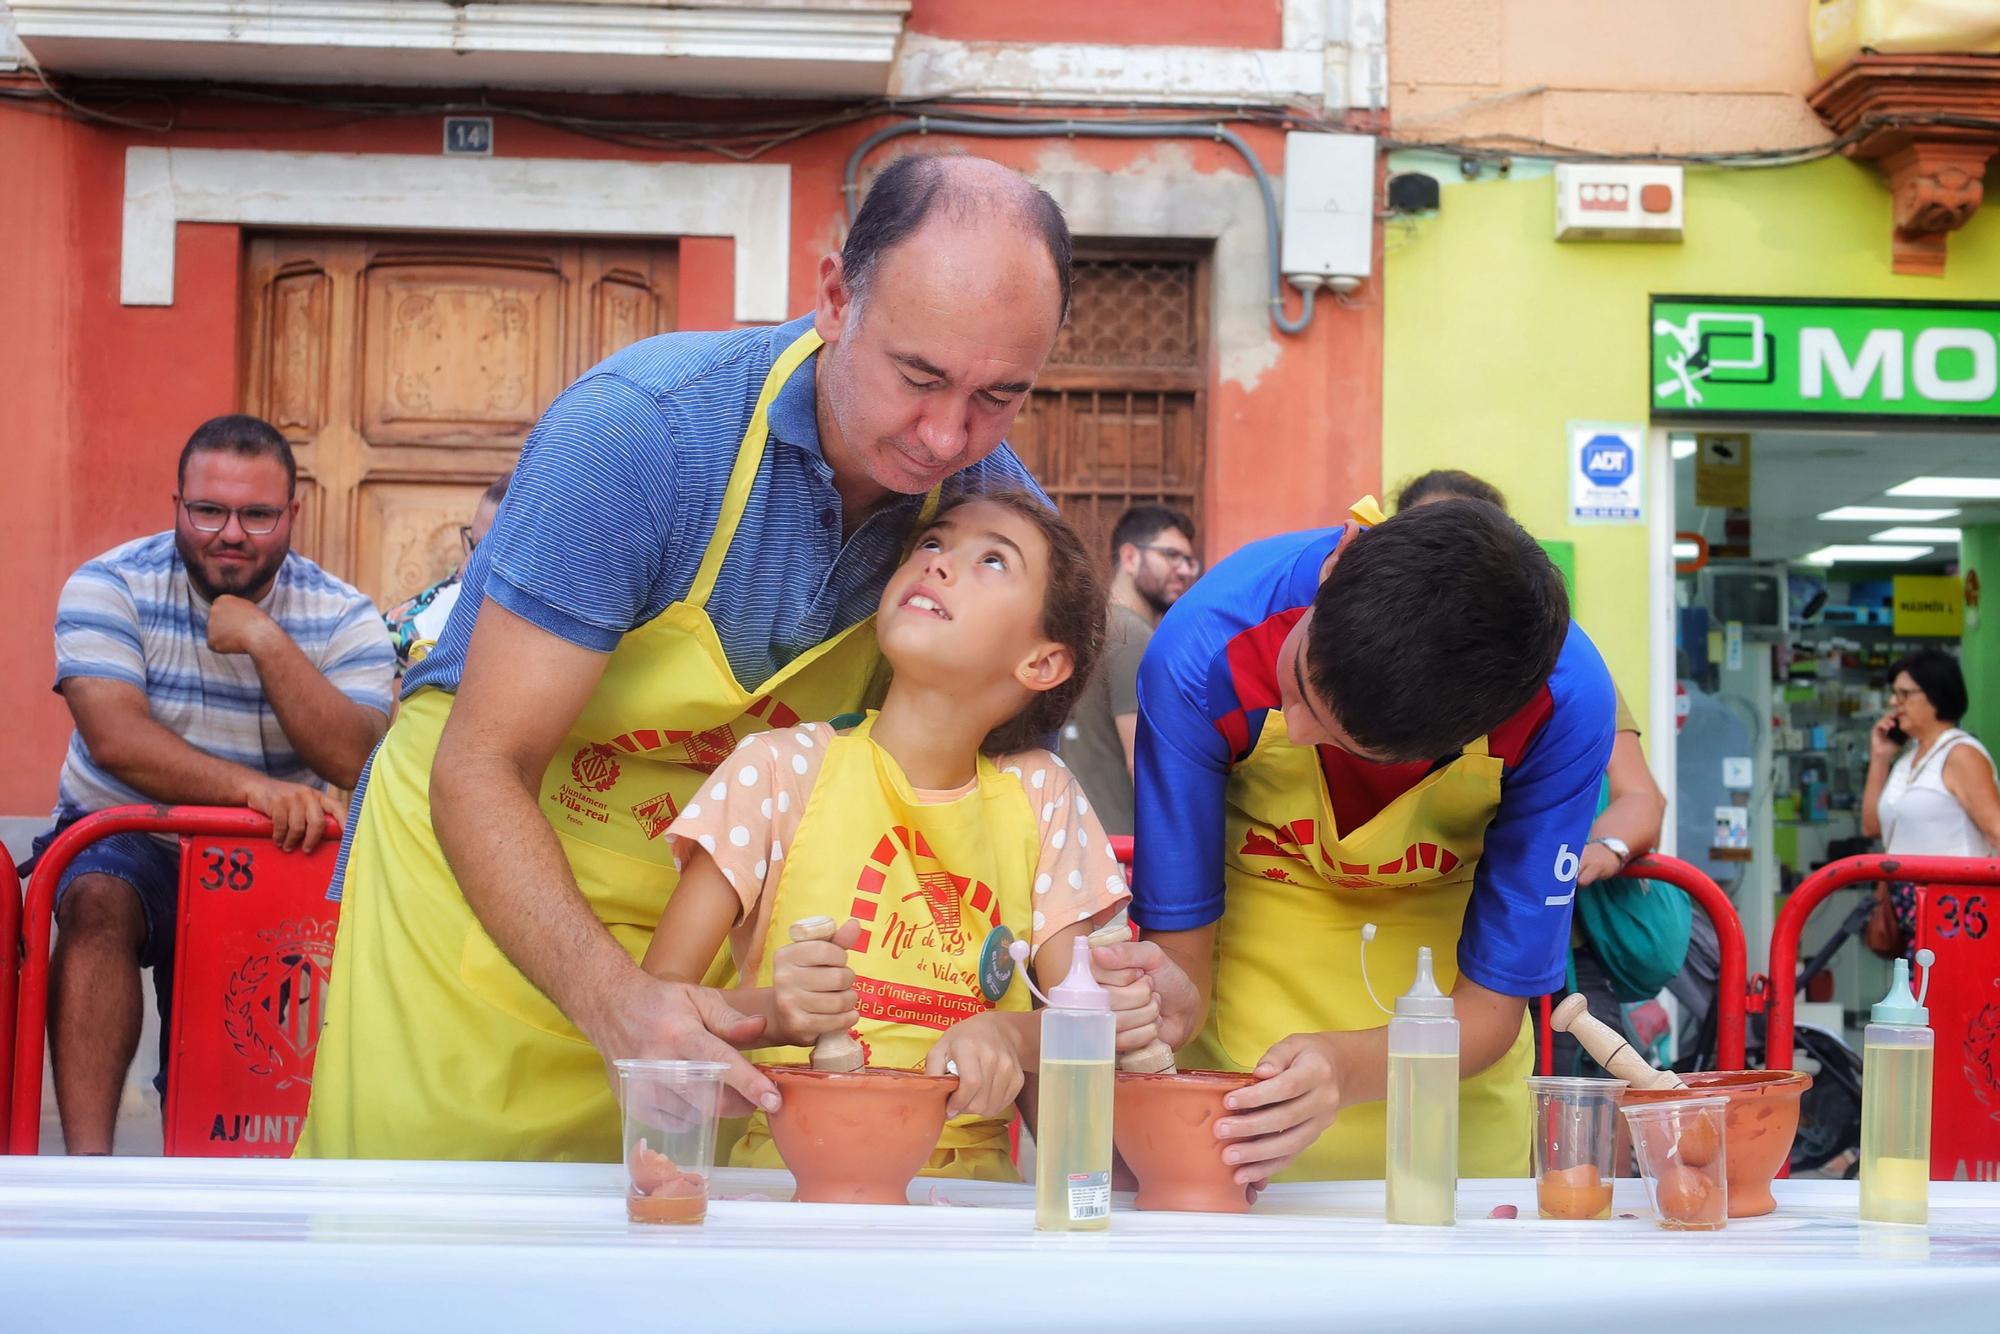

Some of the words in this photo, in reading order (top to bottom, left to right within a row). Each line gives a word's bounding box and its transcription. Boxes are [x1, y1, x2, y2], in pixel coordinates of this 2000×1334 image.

[456, 125, 480, 148] 14
[1800, 327, 2000, 402] MO
[560, 784, 607, 810] Ajuntament
[199, 847, 253, 891] 38
[1935, 895, 1988, 940] 36
[881, 912, 932, 959] Nit
[921, 929, 936, 948] de
[916, 958, 928, 972] de
[852, 980, 875, 995] sta
[877, 984, 933, 1006] d'Interés
[872, 1002, 884, 1016] la
[886, 1004, 955, 1027] Comunitat
[208, 1113, 307, 1144] AJUNT
